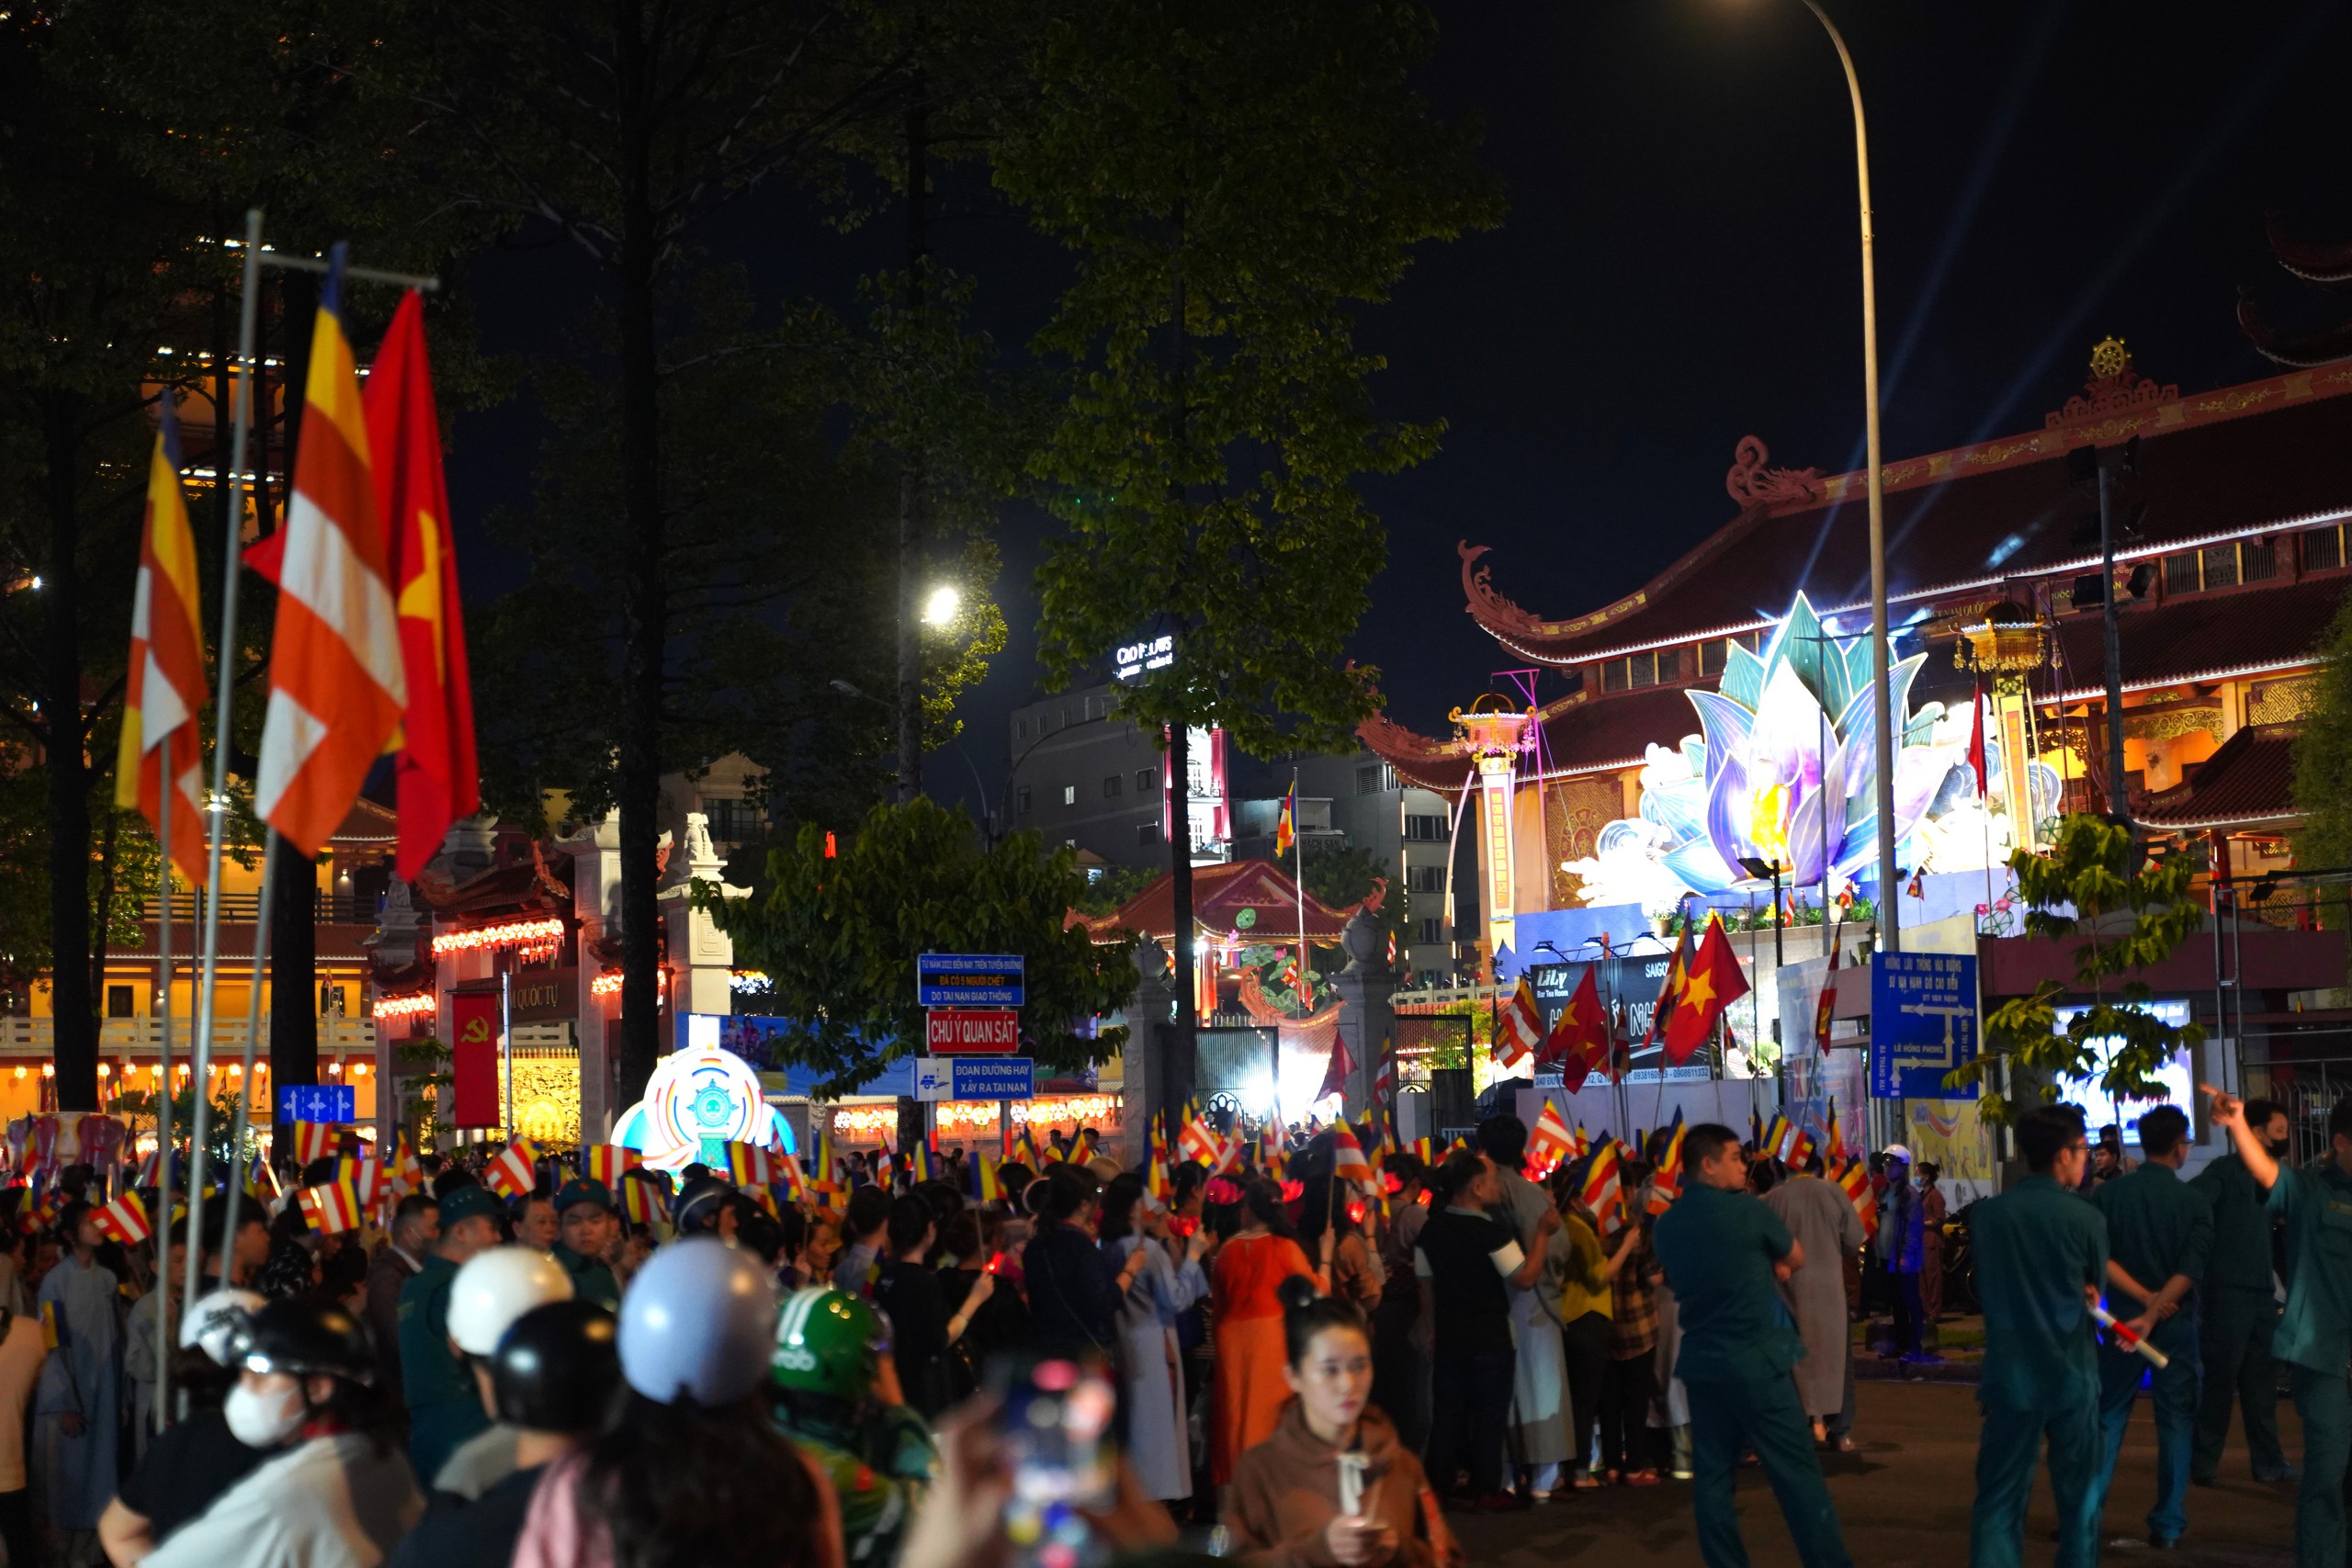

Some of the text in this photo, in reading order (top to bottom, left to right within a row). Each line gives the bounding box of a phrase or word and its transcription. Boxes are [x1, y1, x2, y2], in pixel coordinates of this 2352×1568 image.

[1645, 962, 1670, 978] SAIGO
[496, 989, 516, 1010] NM
[931, 989, 1012, 1004] DO TAI NẠN GIAO THÔNG
[1537, 990, 1545, 998] Bar
[1555, 989, 1569, 998] Room
[931, 1014, 1015, 1043] CHÚ Ý QUAN SÁT
[956, 1063, 1030, 1078] ĐOẠN ĐƯỜNG HAY
[978, 1083, 992, 1093] RA
[992, 1083, 1007, 1093] TAI
[1007, 1083, 1027, 1095] NẠN
[770, 1348, 817, 1372] rab
